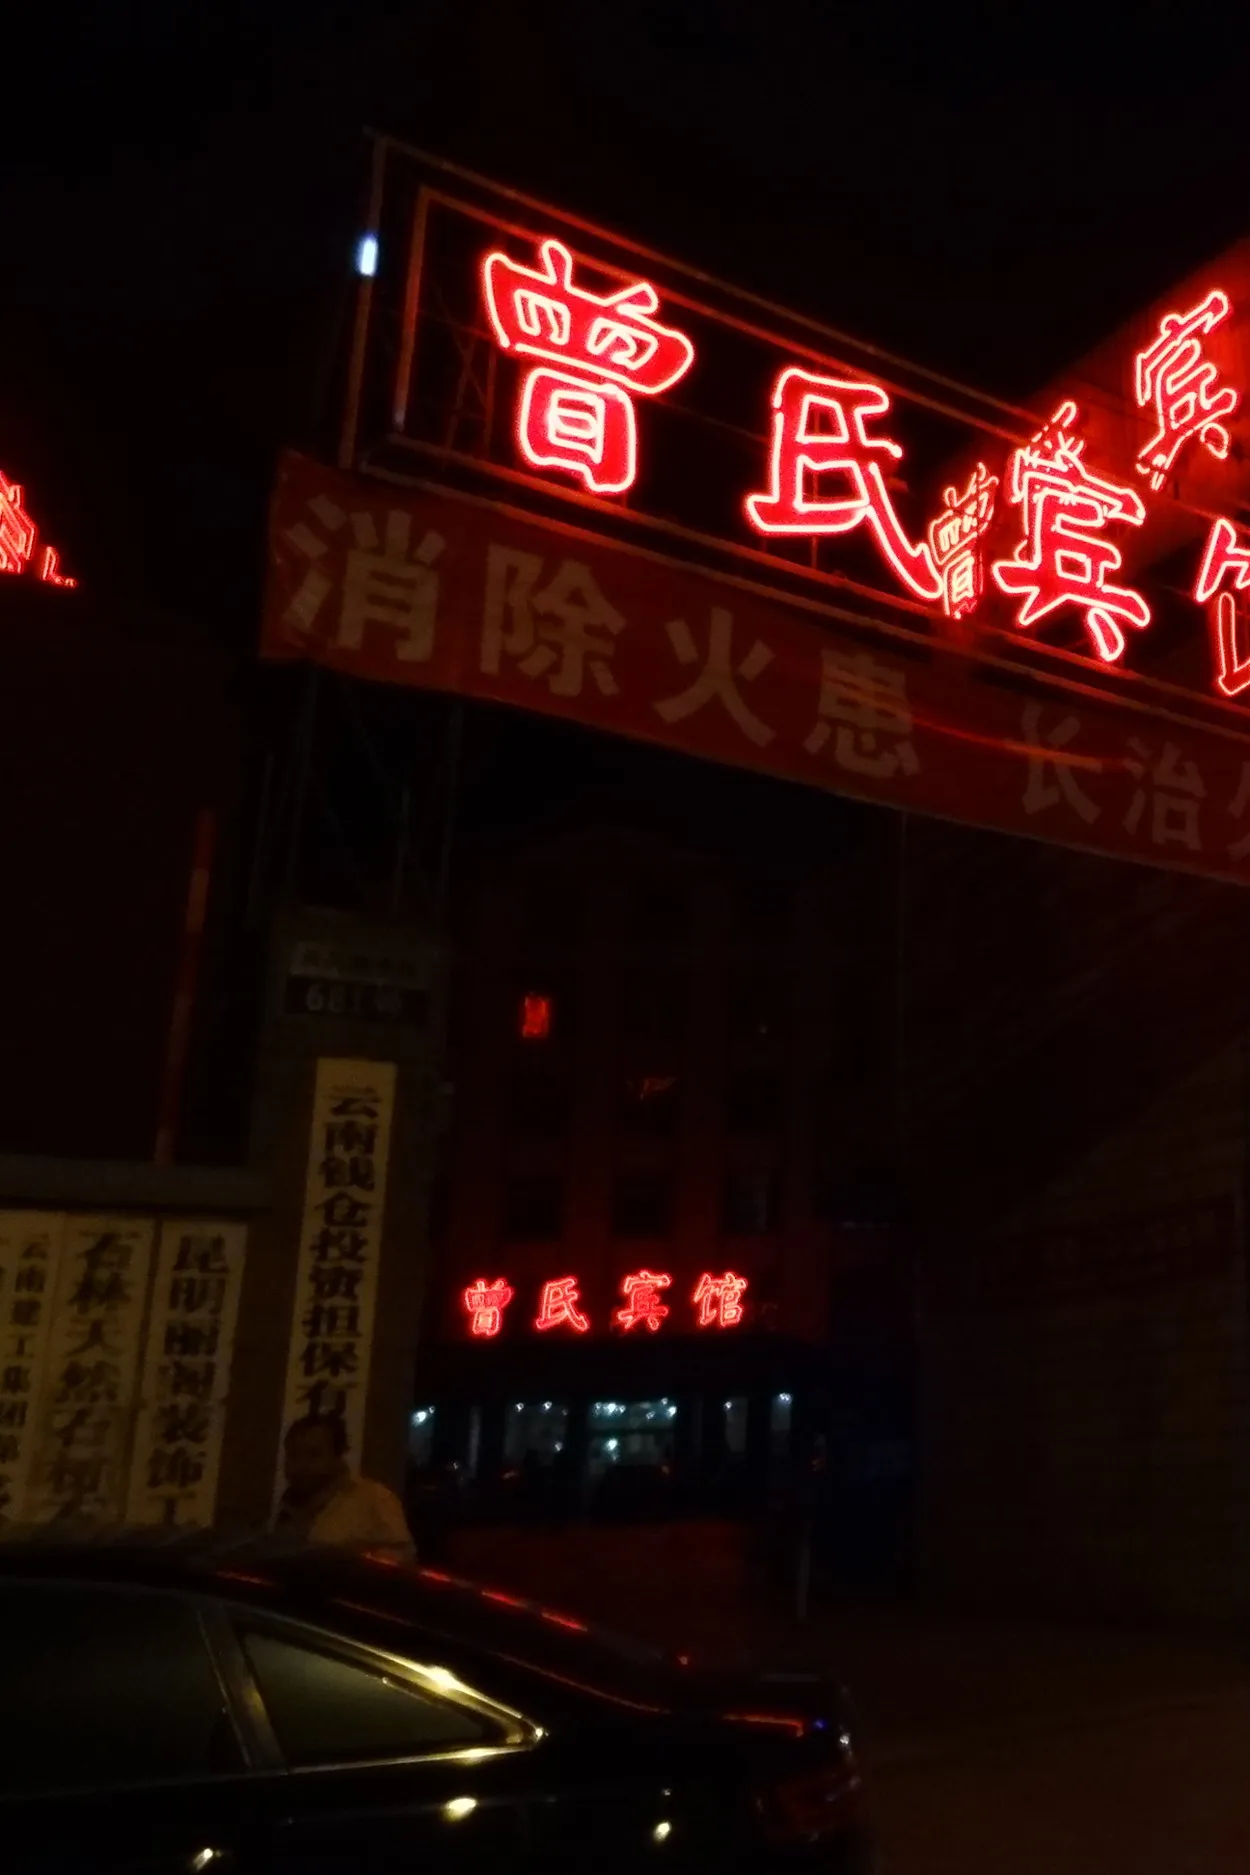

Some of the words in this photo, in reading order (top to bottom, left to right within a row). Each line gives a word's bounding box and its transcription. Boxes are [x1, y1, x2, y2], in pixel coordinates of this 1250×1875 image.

[278, 494, 923, 782] 消除火患
[462, 1268, 749, 1338] 曾氏宾馆
